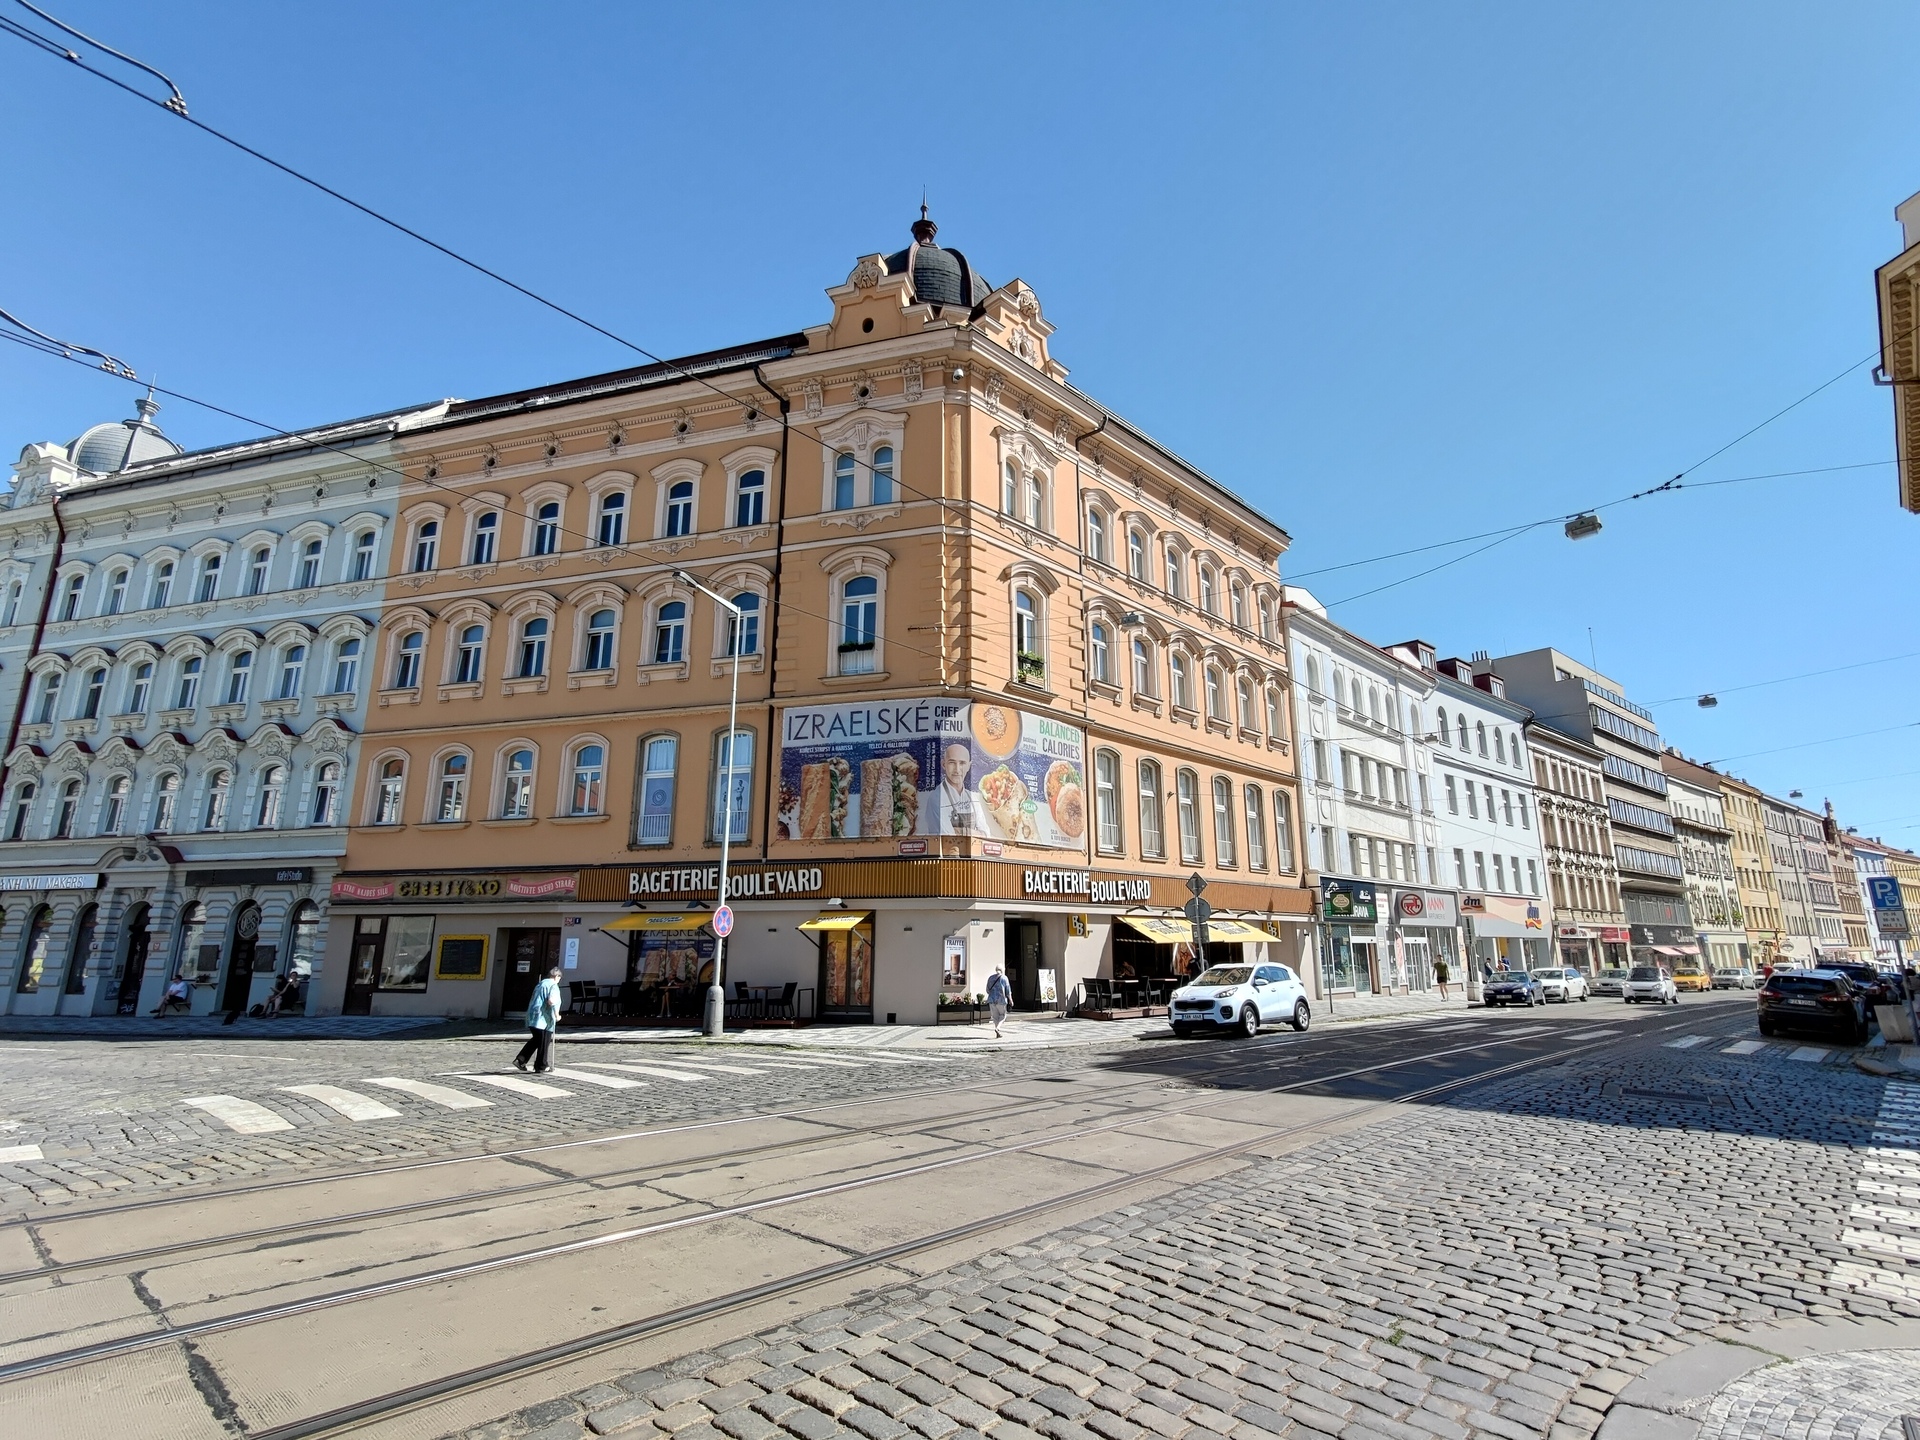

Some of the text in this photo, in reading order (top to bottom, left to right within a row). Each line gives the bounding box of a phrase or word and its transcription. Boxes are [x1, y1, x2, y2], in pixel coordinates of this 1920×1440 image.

[787, 700, 929, 741] IZRAELSKÉ
[934, 706, 959, 719] CHEF
[934, 719, 963, 732] MENU
[1039, 719, 1080, 744] BALANCED
[1042, 737, 1080, 760] CALORIES
[1022, 803, 1037, 811] VEGAN
[45, 876, 85, 889] MAKERS
[629, 867, 822, 898] BAGETERIE BOULEVARD
[1025, 870, 1151, 902] BAGETERIE BOULEVARD
[1874, 881, 1893, 899] P
[1463, 896, 1481, 906] dm
